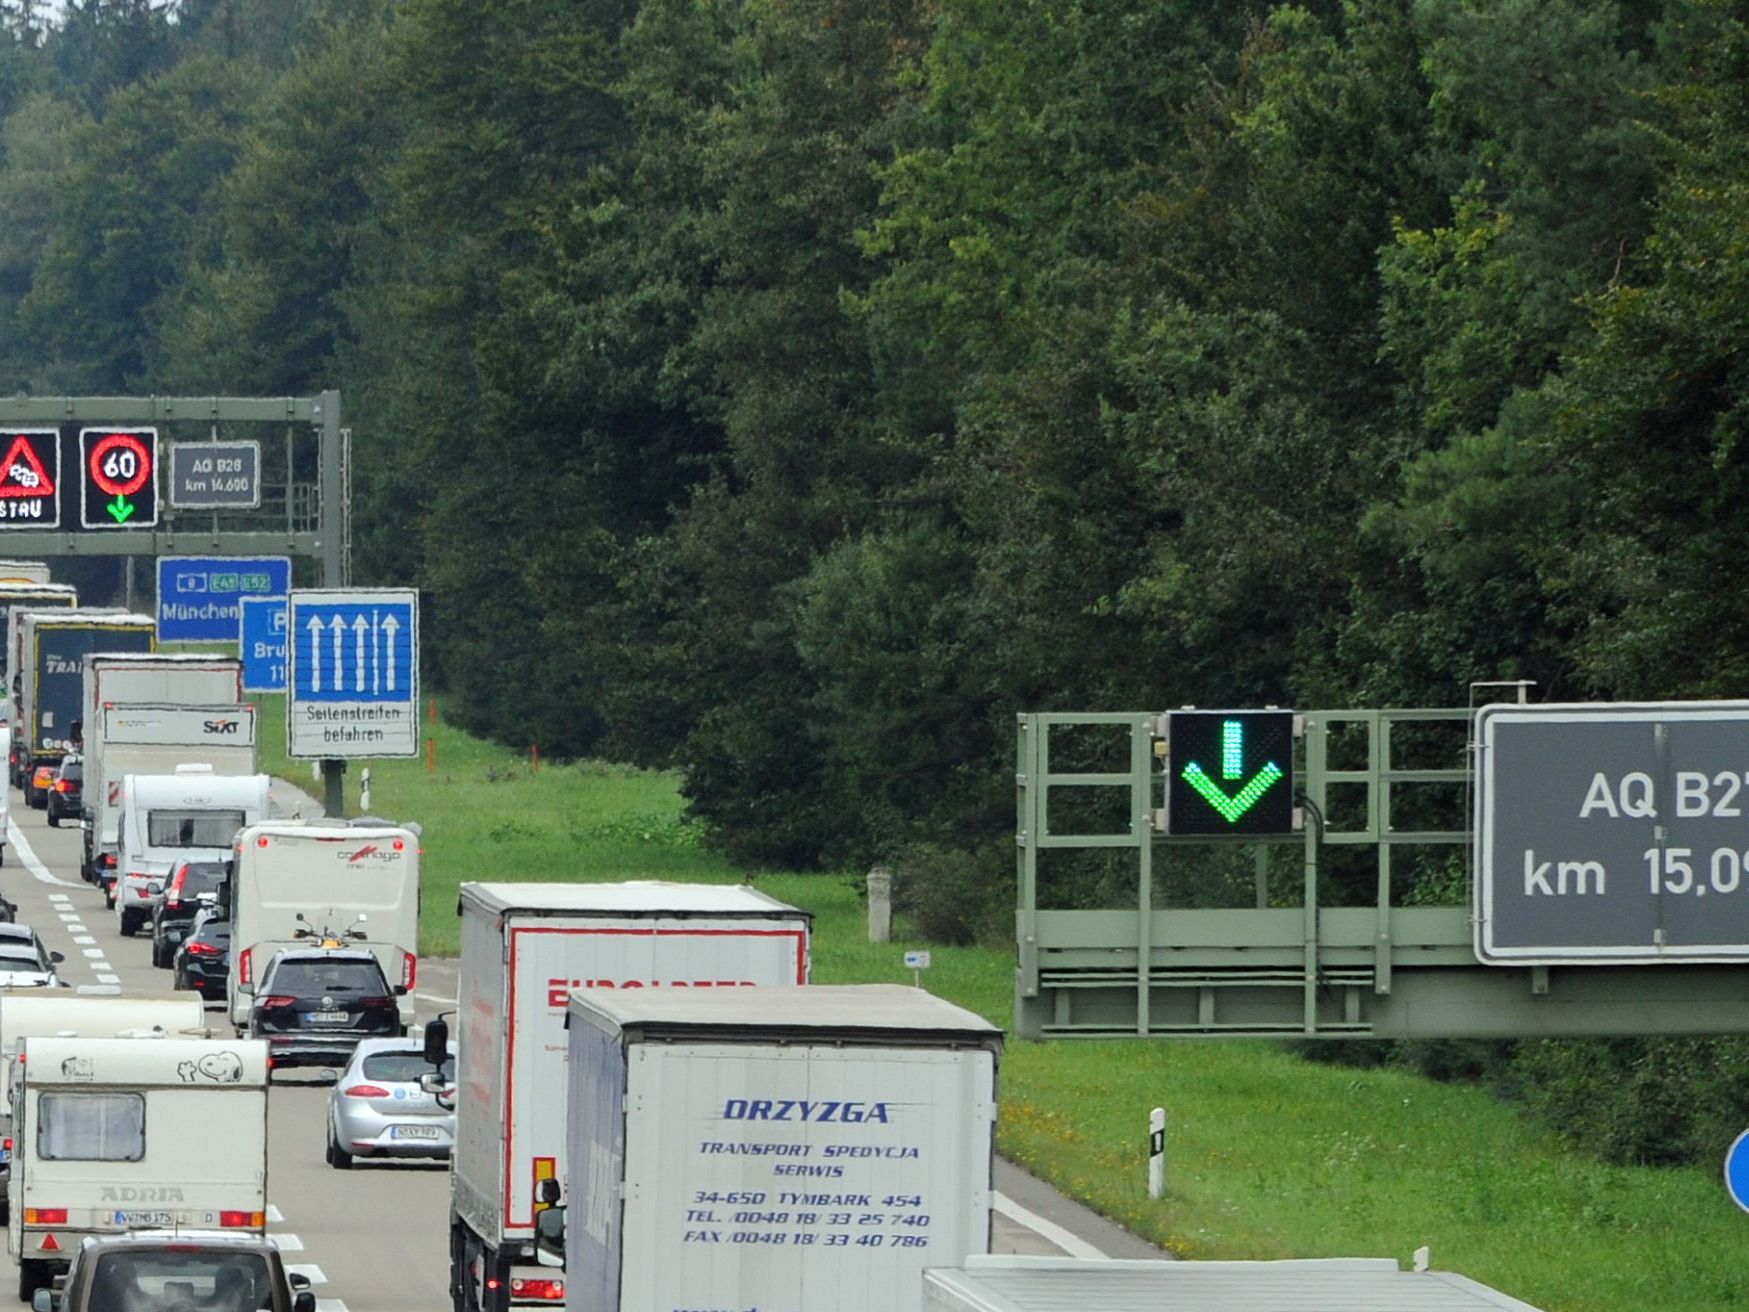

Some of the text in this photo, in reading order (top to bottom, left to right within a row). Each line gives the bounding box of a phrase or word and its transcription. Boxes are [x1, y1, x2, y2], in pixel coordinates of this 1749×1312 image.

[103, 450, 135, 479] 60
[192, 459, 212, 474] AQ
[185, 477, 207, 492] km
[162, 602, 239, 620] München
[307, 705, 401, 721] Seitenstreifen
[324, 725, 383, 743] befahren
[1579, 771, 1749, 818] AQ B2
[1523, 850, 1605, 894] km
[723, 1099, 890, 1124] DRZYZGA
[700, 1142, 919, 1159] TRANSPORT SPEDYCJA
[773, 1164, 844, 1178] SERWIS
[101, 1186, 184, 1202] ADRIA
[693, 1191, 922, 1207] 34-650 TYMBARK 454
[206, 1213, 213, 1223] D
[686, 1210, 721, 1223] TEL.
[827, 1213, 851, 1225] 33
[857, 1213, 884, 1225] 25
[890, 1214, 930, 1227] 740
[683, 1231, 722, 1243] FAX
[824, 1234, 849, 1246] 33
[855, 1234, 883, 1247] 40
[890, 1235, 930, 1247] 786
